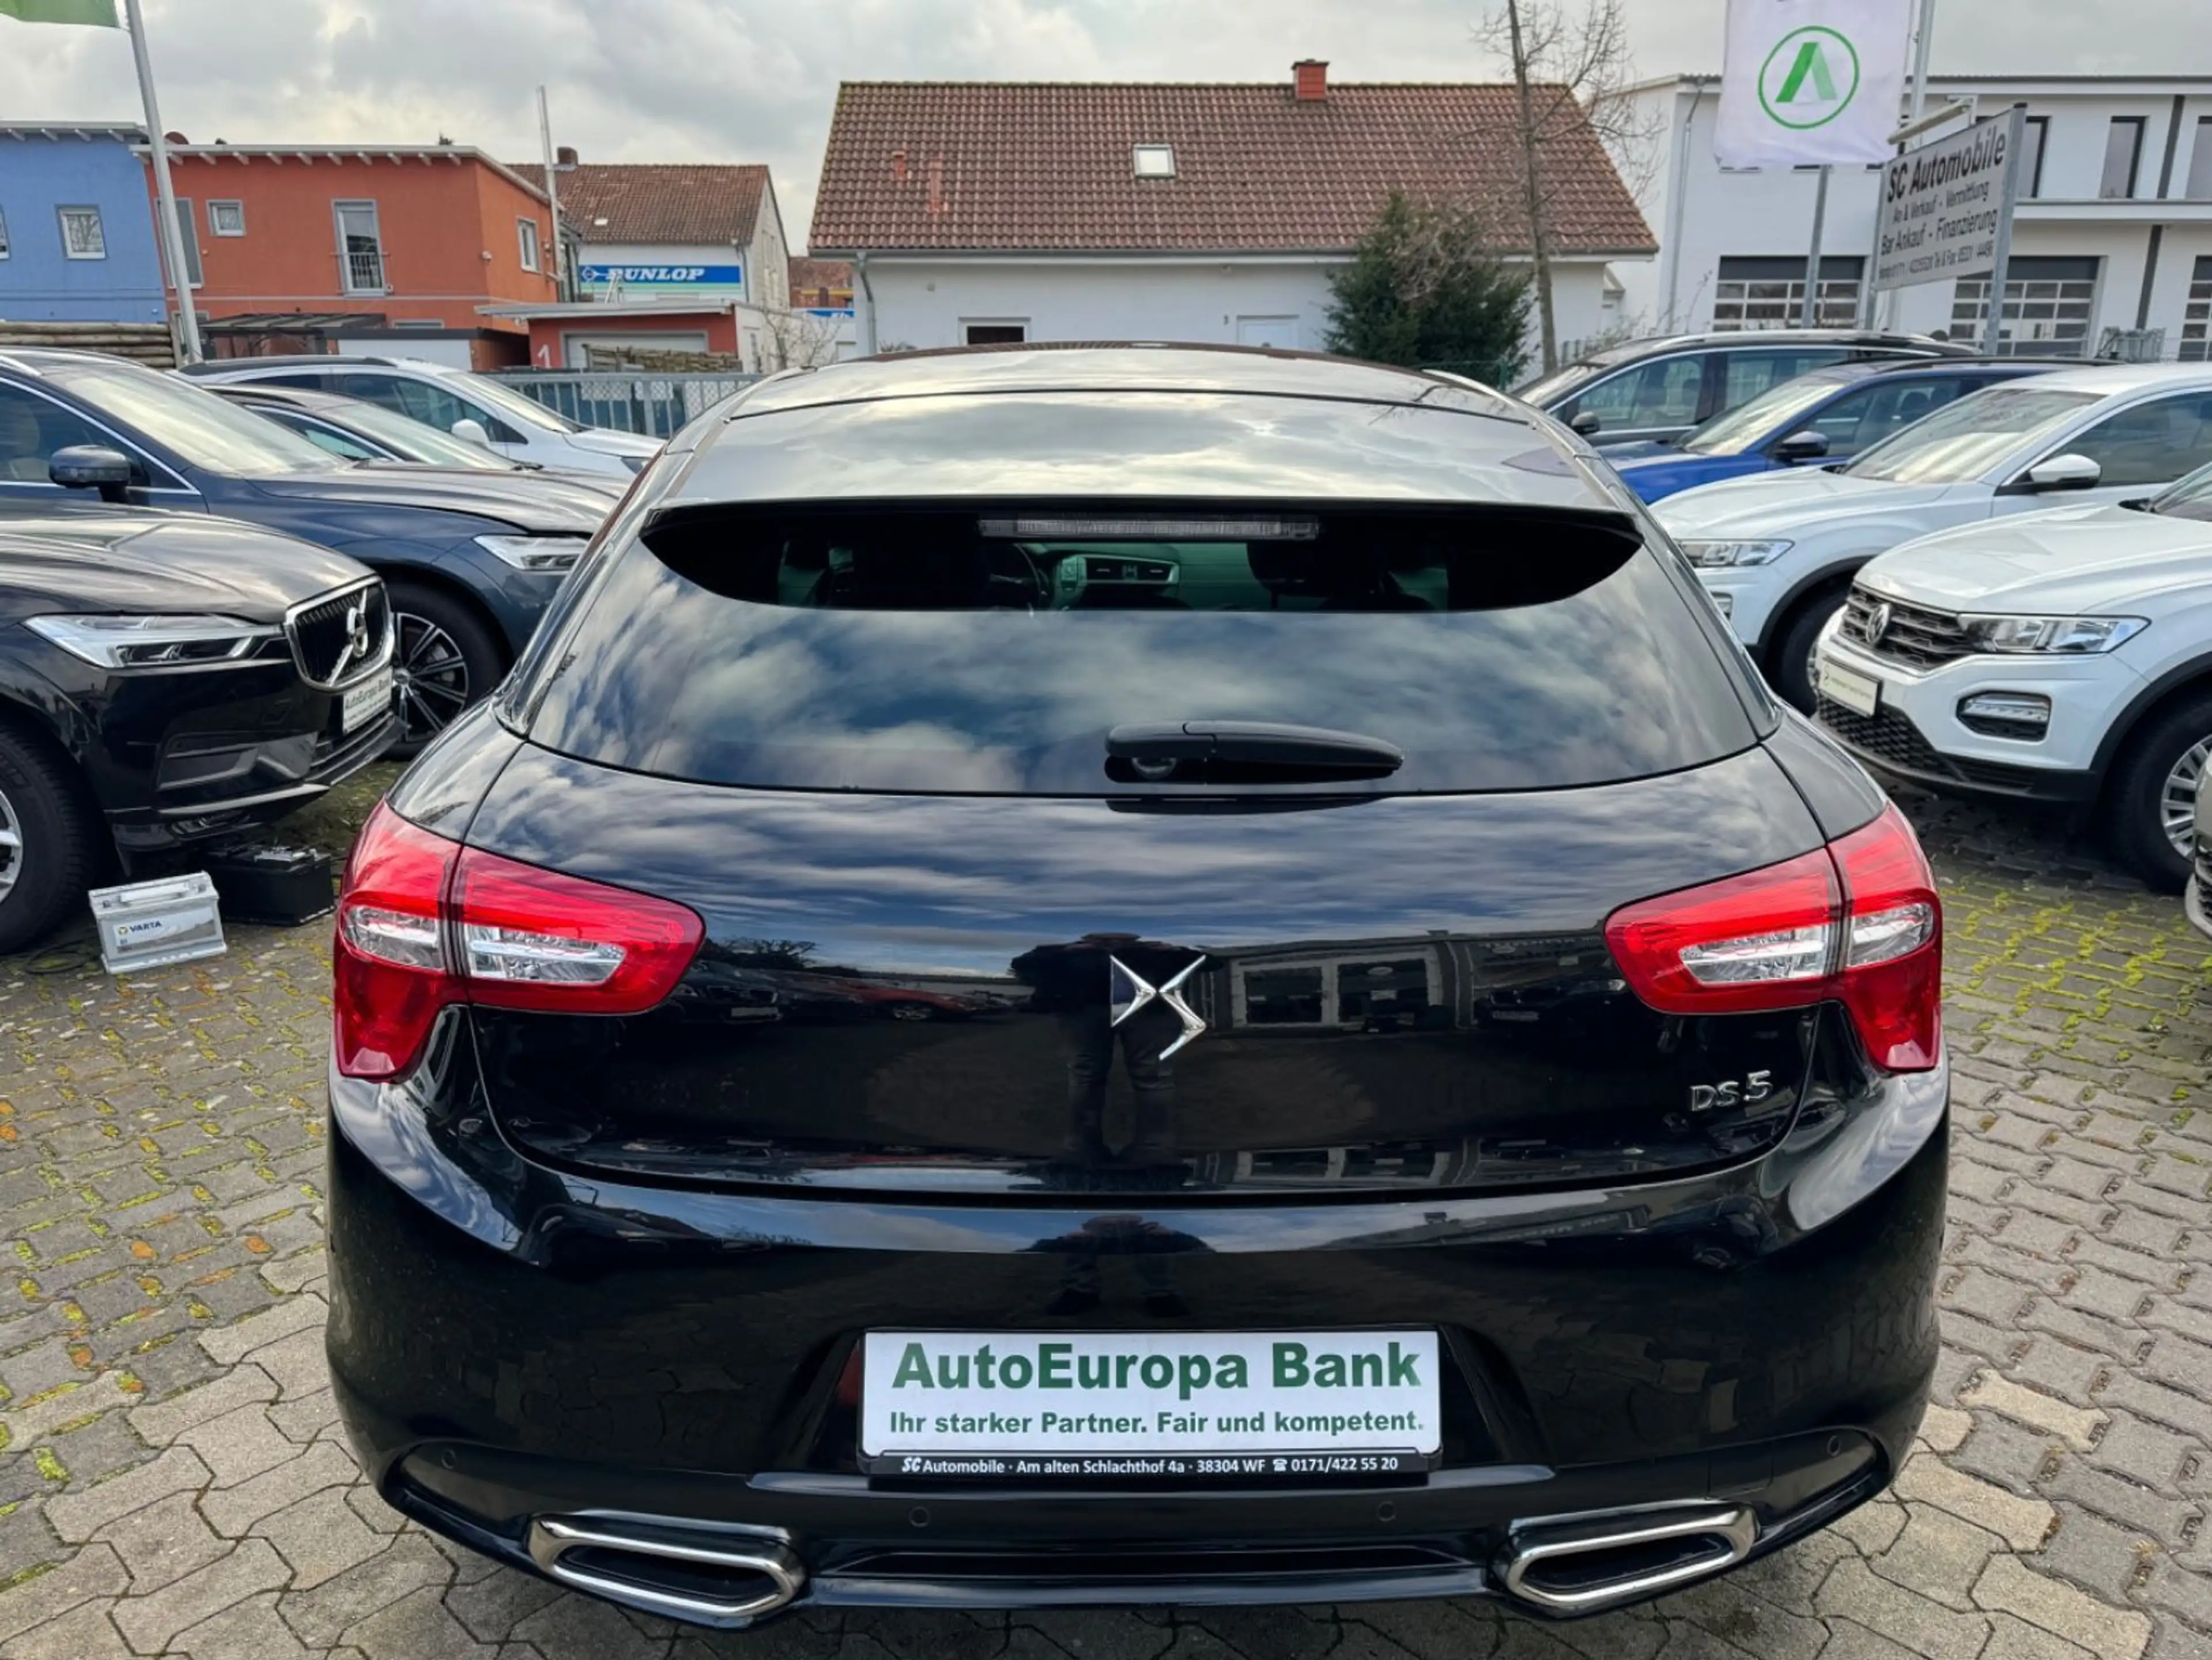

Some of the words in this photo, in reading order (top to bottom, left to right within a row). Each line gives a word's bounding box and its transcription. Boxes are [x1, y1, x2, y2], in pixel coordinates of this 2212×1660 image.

[1888, 161, 1908, 203] SC
[1909, 126, 2006, 196] Automobile
[1894, 222, 1927, 252] Ankauf
[1935, 209, 1998, 241] Finanzierung
[130, 921, 162, 933] VARTA
[892, 1342, 1248, 1401] AutoEuropa
[1272, 1342, 1421, 1388] Bank
[890, 1412, 926, 1433] Ihr
[935, 1412, 1033, 1433] starker
[1041, 1412, 1147, 1433] Partner.
[1157, 1412, 1209, 1433] Fair
[1217, 1412, 1264, 1432] und
[1274, 1410, 1423, 1436] kompetent.
[902, 1457, 921, 1473] SC
[922, 1460, 1005, 1473] Automobile
[1016, 1460, 1041, 1473] Am
[1044, 1460, 1079, 1474] alten
[1082, 1459, 1165, 1473] Schlachthof
[1168, 1460, 1185, 1473] 4a
[1197, 1459, 1239, 1473] 38304
[1242, 1459, 1266, 1472] WF
[1291, 1457, 1357, 1473] 0171/422
[1361, 1457, 1378, 1470] 55
[1381, 1457, 1398, 1470] 20
